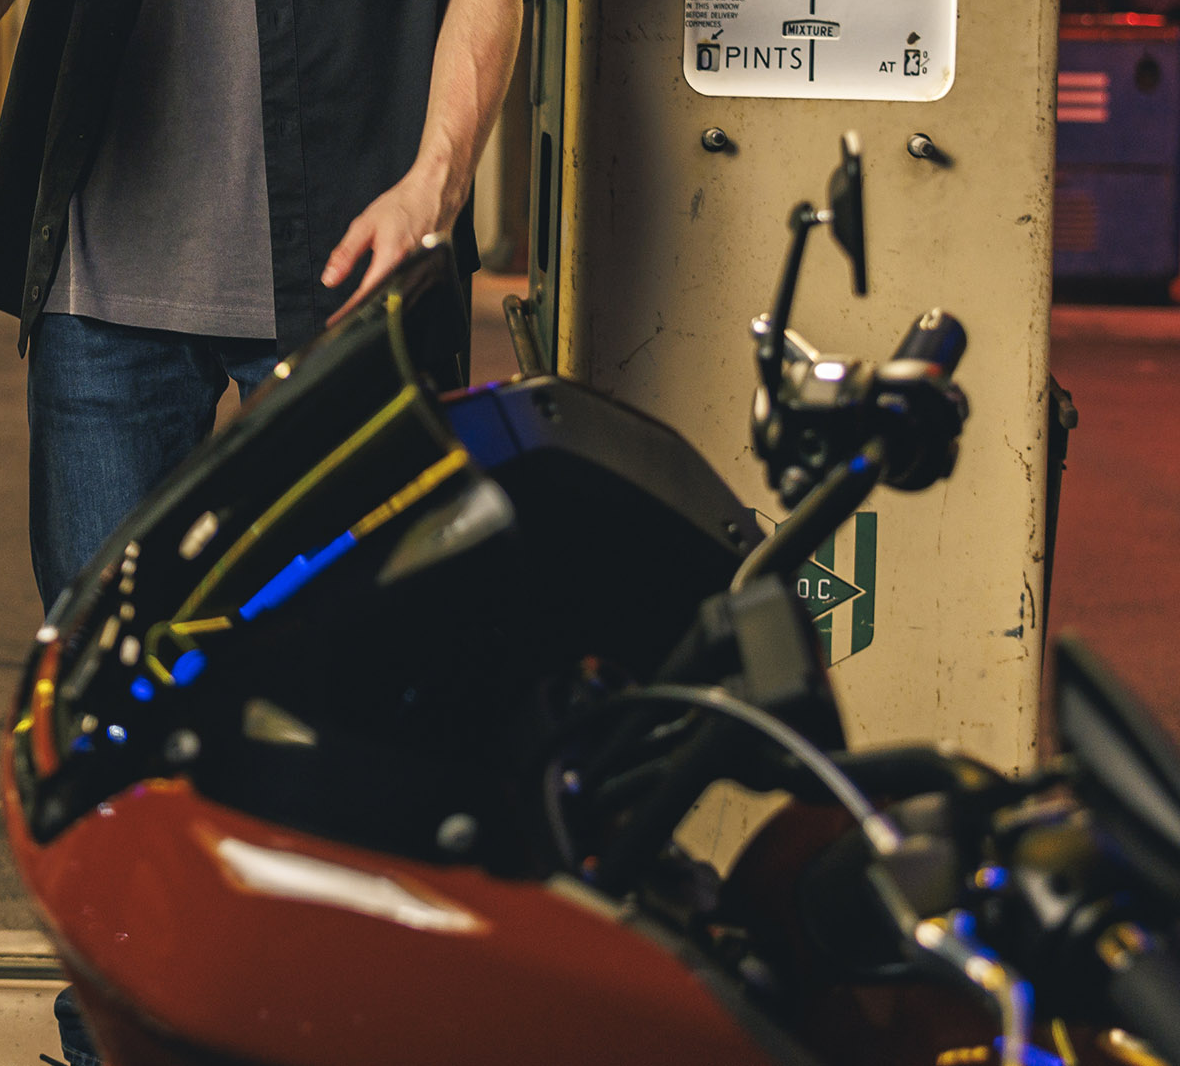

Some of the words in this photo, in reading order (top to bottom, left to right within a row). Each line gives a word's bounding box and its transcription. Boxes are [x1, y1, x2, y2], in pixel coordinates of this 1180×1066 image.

[787, 24, 833, 37] MIXTURE
[725, 46, 802, 69] PINTS
[879, 61, 896, 73] AT
